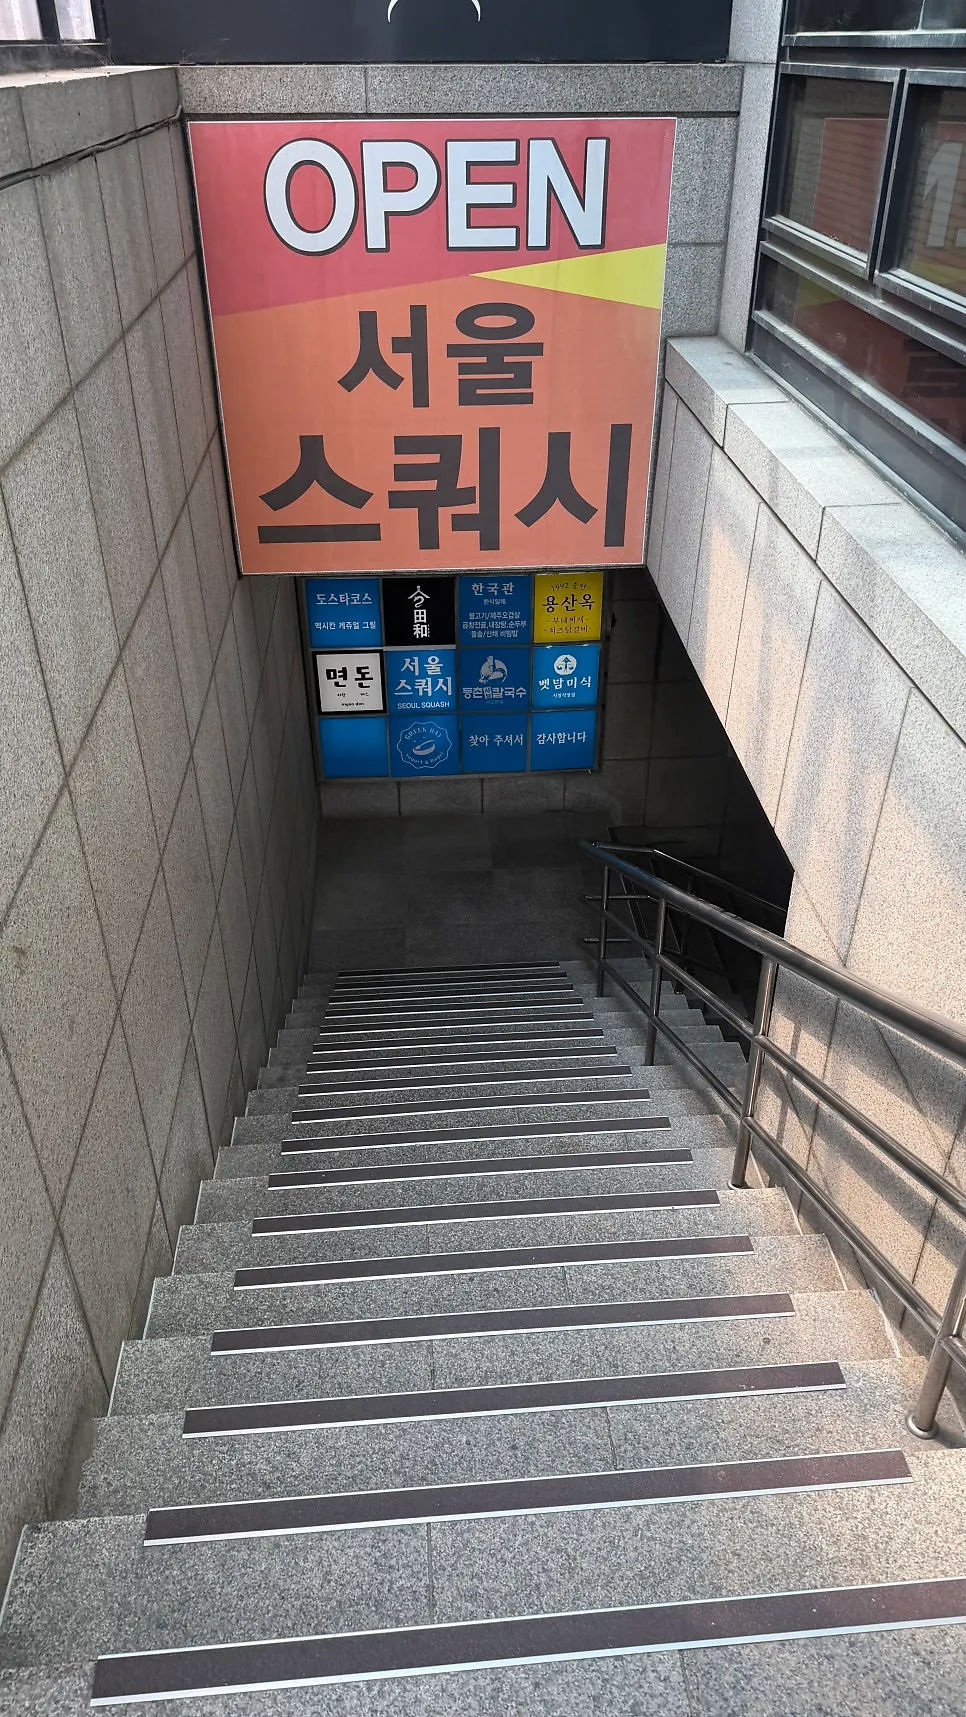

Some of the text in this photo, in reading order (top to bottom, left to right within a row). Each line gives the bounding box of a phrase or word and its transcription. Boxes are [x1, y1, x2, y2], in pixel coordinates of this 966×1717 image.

[263, 137, 610, 256] OPEN
[337, 302, 544, 408] 서울
[257, 423, 634, 552] 스쿼시
[472, 582, 514, 596] 한국관
[551, 582, 569, 591] 1992
[316, 593, 372, 606] 도스타코스
[542, 593, 595, 613] 용산옥
[401, 656, 443, 676] 서울
[394, 677, 452, 697] 스쿼시
[421, 701, 450, 709] SQUASH
[469, 734, 523, 747] 찾아 주셔서
[536, 731, 587, 745] 감사합니다
